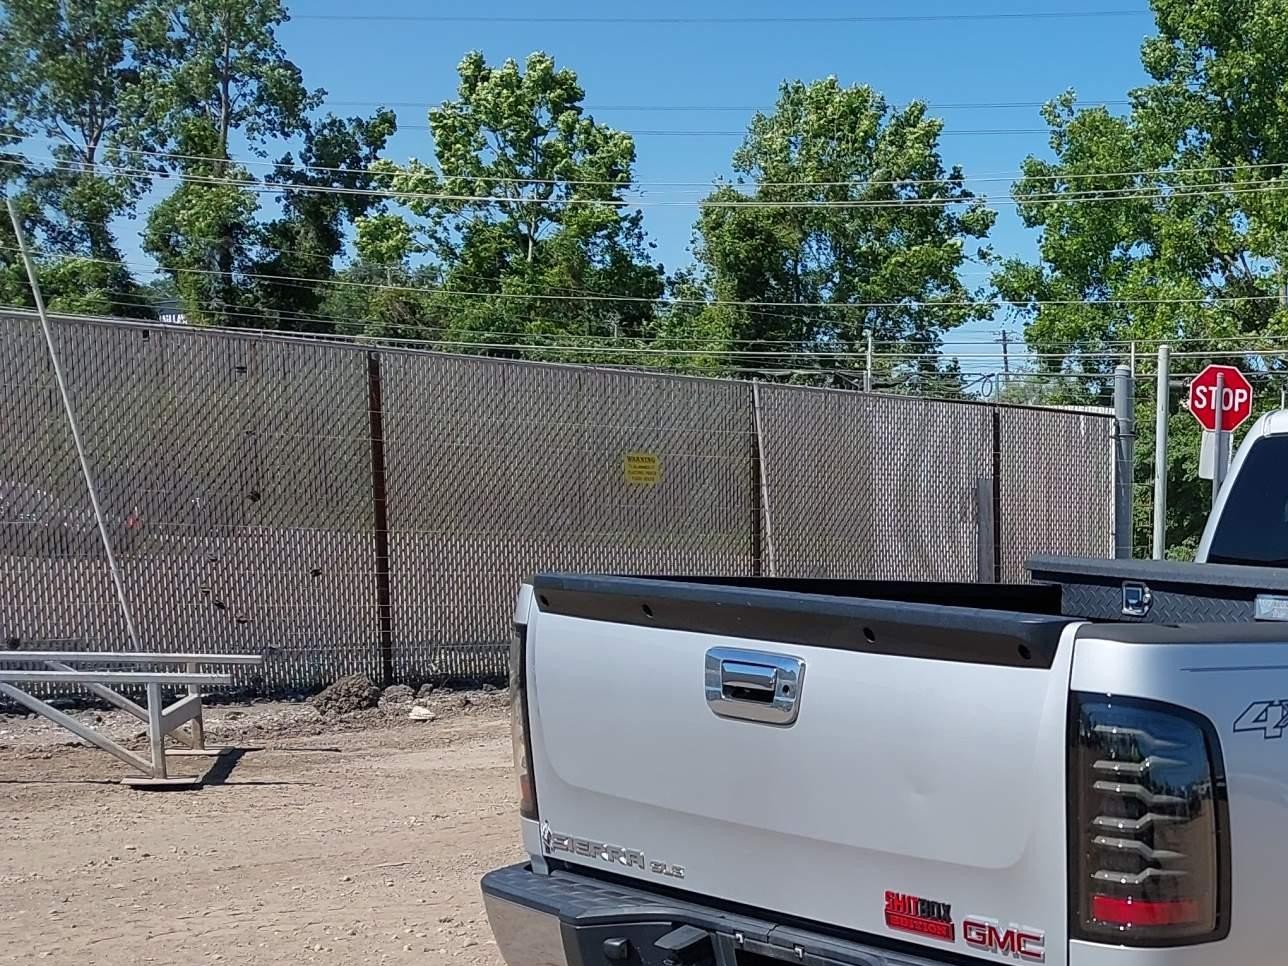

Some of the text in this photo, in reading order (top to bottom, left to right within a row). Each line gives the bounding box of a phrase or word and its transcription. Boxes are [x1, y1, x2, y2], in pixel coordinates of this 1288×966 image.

[1194, 385, 1248, 412] STOP
[551, 831, 645, 869] SIERRA
[884, 890, 952, 922] SHITBOX
[963, 915, 1045, 963] GMC
